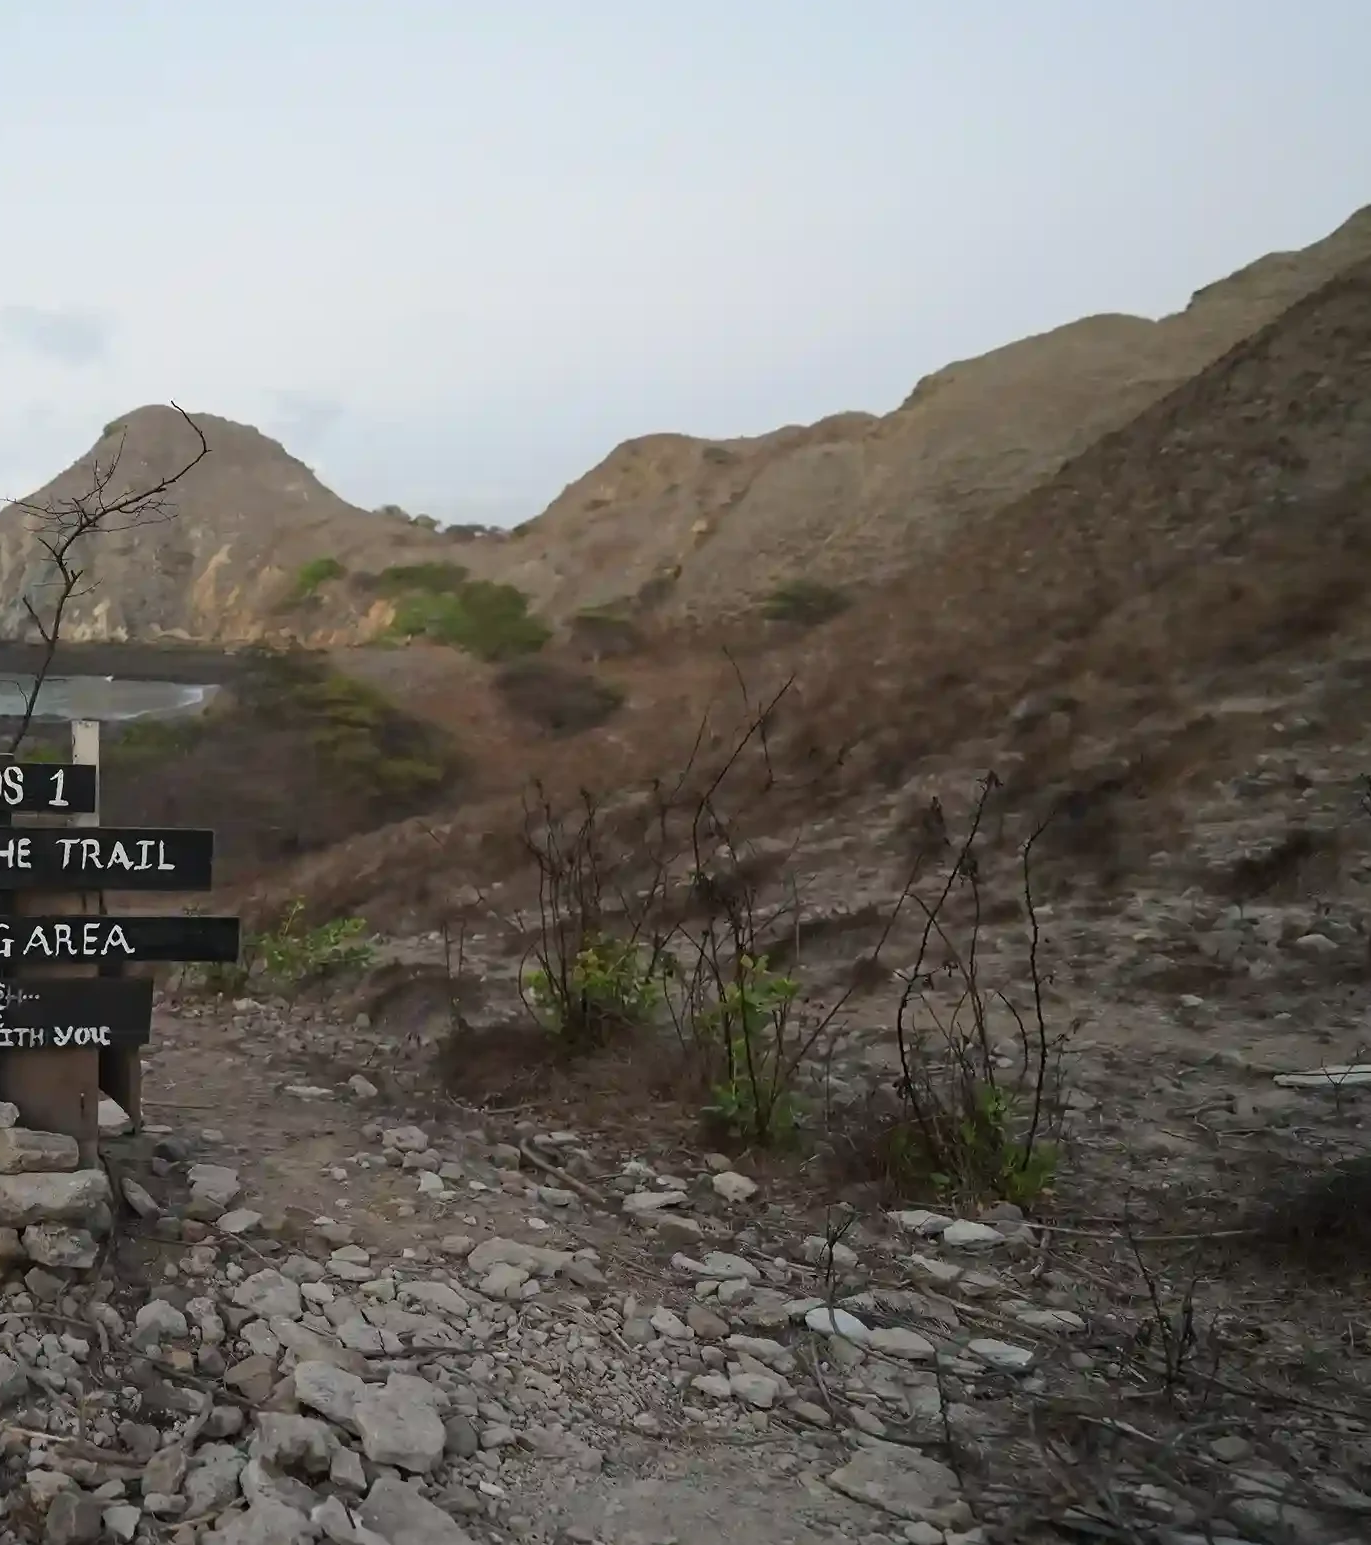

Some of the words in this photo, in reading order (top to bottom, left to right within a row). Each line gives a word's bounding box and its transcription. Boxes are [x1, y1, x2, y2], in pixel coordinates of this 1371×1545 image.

[48, 768, 69, 807] 1
[55, 838, 176, 870] TRAIL
[22, 922, 136, 956] AREA
